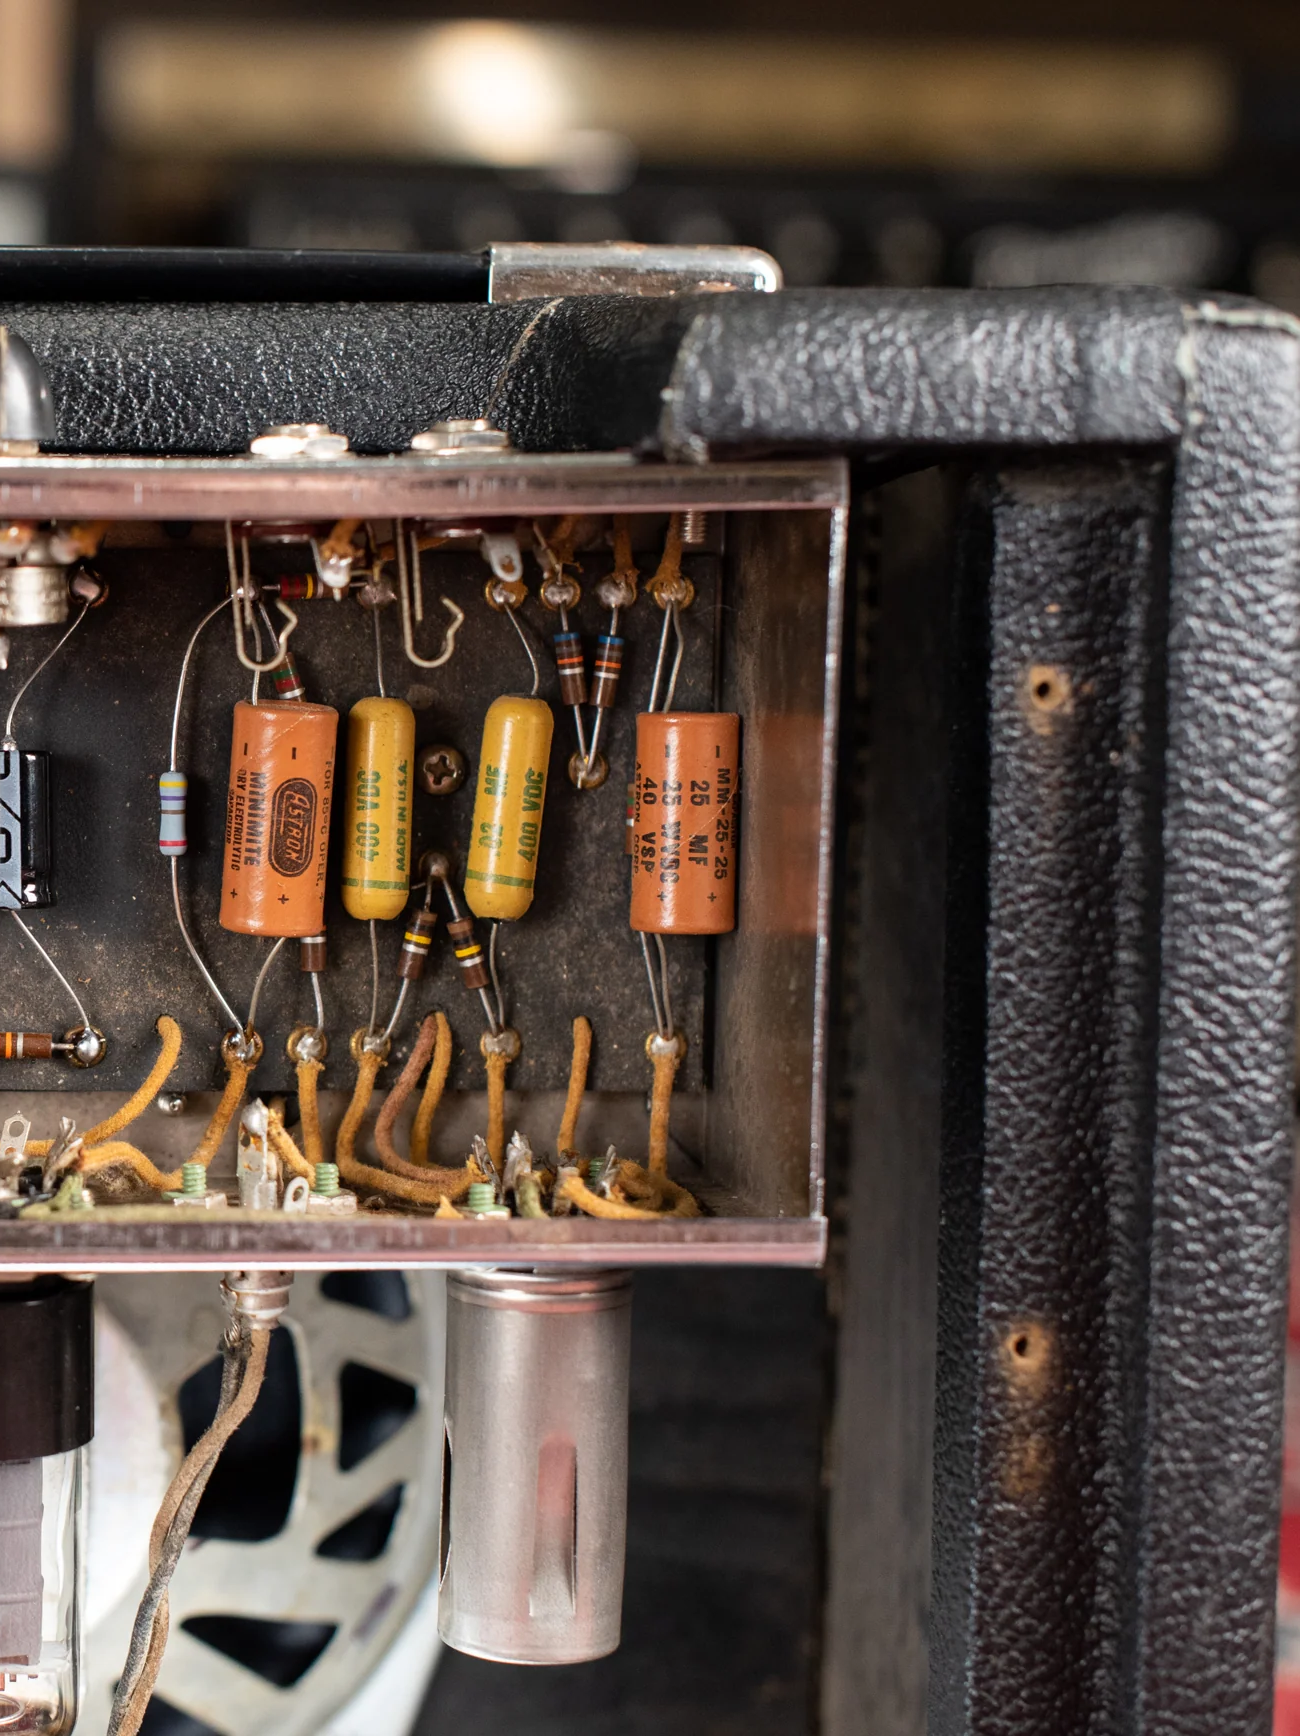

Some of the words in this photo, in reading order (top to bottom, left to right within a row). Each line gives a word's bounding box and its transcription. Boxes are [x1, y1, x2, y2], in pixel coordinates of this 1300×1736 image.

[237, 769, 247, 790] DRY
[356, 770, 381, 811] VDC
[398, 760, 408, 801] U.S.A.
[521, 767, 544, 811] VDC
[634, 762, 642, 823] ASTRON
[643, 777, 658, 805] 40
[662, 779, 683, 807] 25
[690, 780, 710, 806] 25
[232, 795, 245, 870] ELECTROLYTIC
[244, 771, 266, 866] MINIMITE
[398, 806, 407, 822] IN
[714, 768, 731, 880] MM-25-25
[356, 822, 380, 862] 400
[397, 828, 406, 871] MADE
[518, 822, 538, 862] 400
[640, 831, 656, 874] VSP
[659, 820, 681, 884] WVDC
[688, 834, 709, 867] MF
